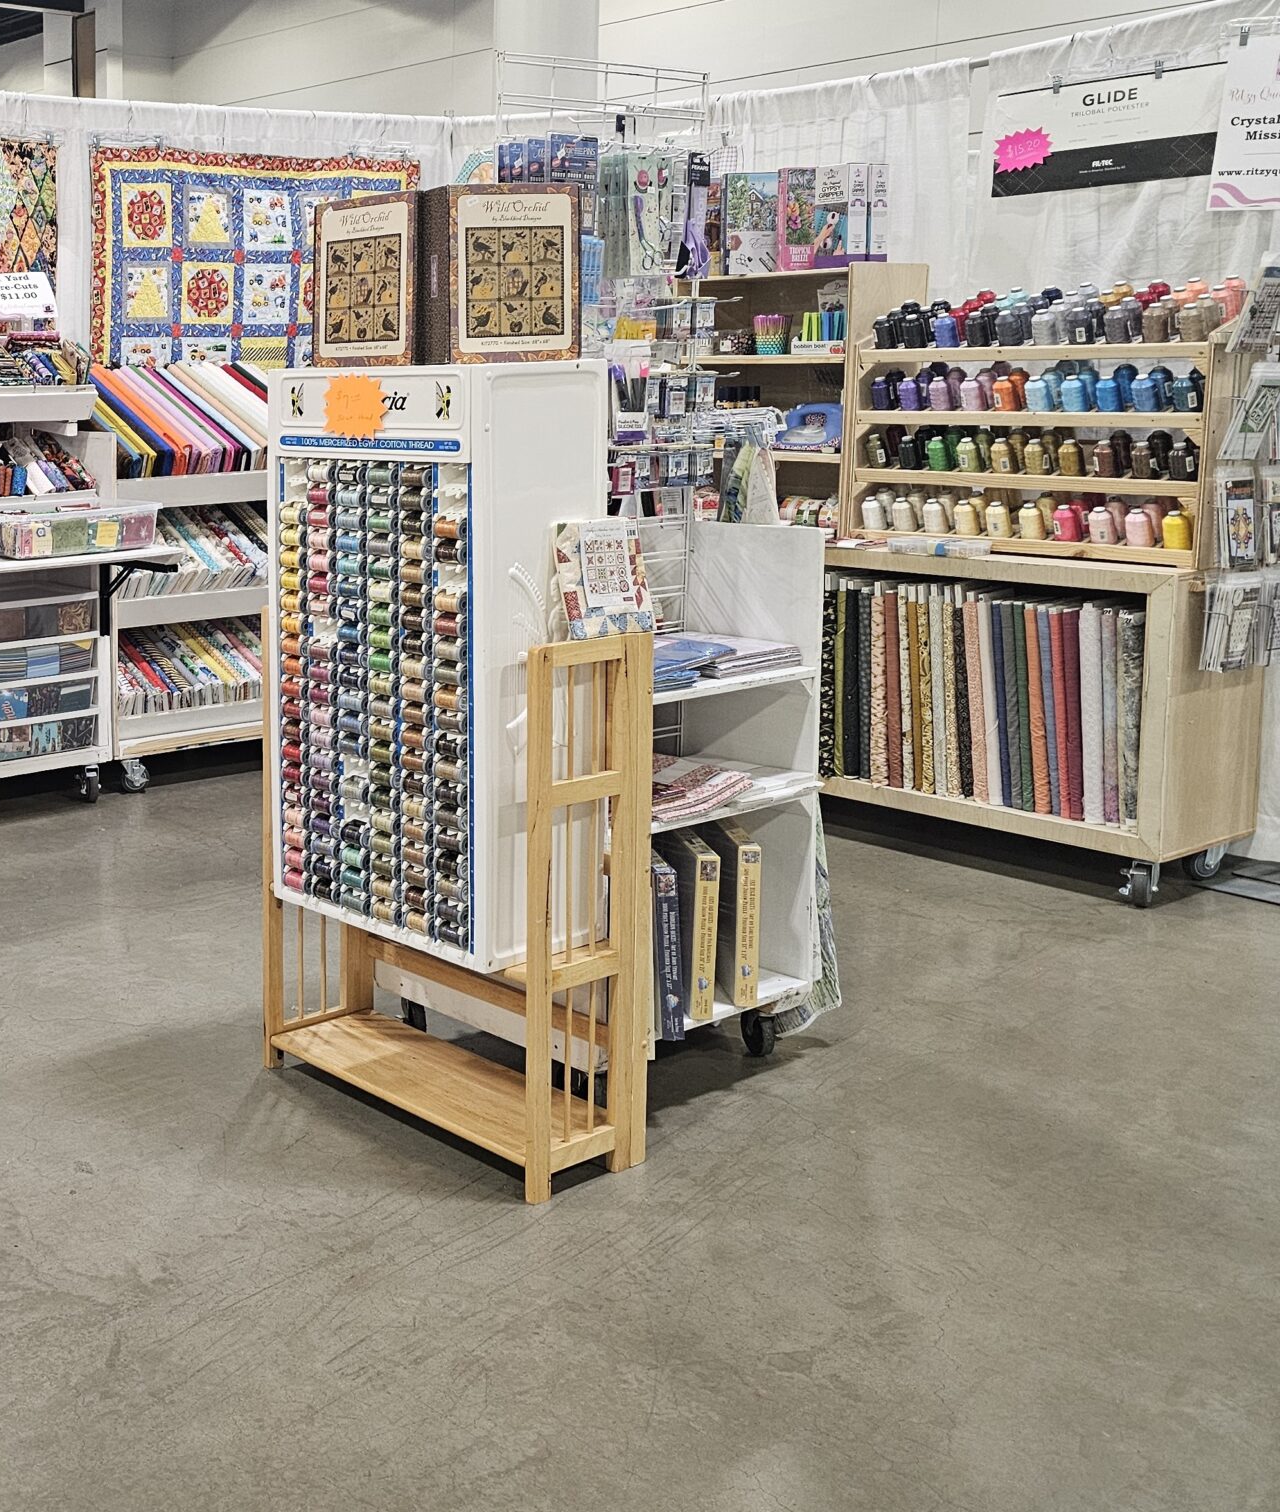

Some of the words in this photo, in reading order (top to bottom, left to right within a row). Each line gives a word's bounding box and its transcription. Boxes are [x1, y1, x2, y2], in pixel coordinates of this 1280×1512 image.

[1082, 88, 1138, 106] GLIDE
[1072, 109, 1104, 117] TRILOBAL
[1108, 102, 1149, 112] POLYESTER
[483, 200, 510, 213] Wild
[513, 200, 550, 212] Orchid
[340, 213, 360, 226] Wild
[362, 210, 392, 224] Orchid
[0, 292, 38, 300] $11.00
[301, 437, 318, 445] 100%
[380, 440, 407, 448] COTTON
[409, 441, 434, 449] THREAD
